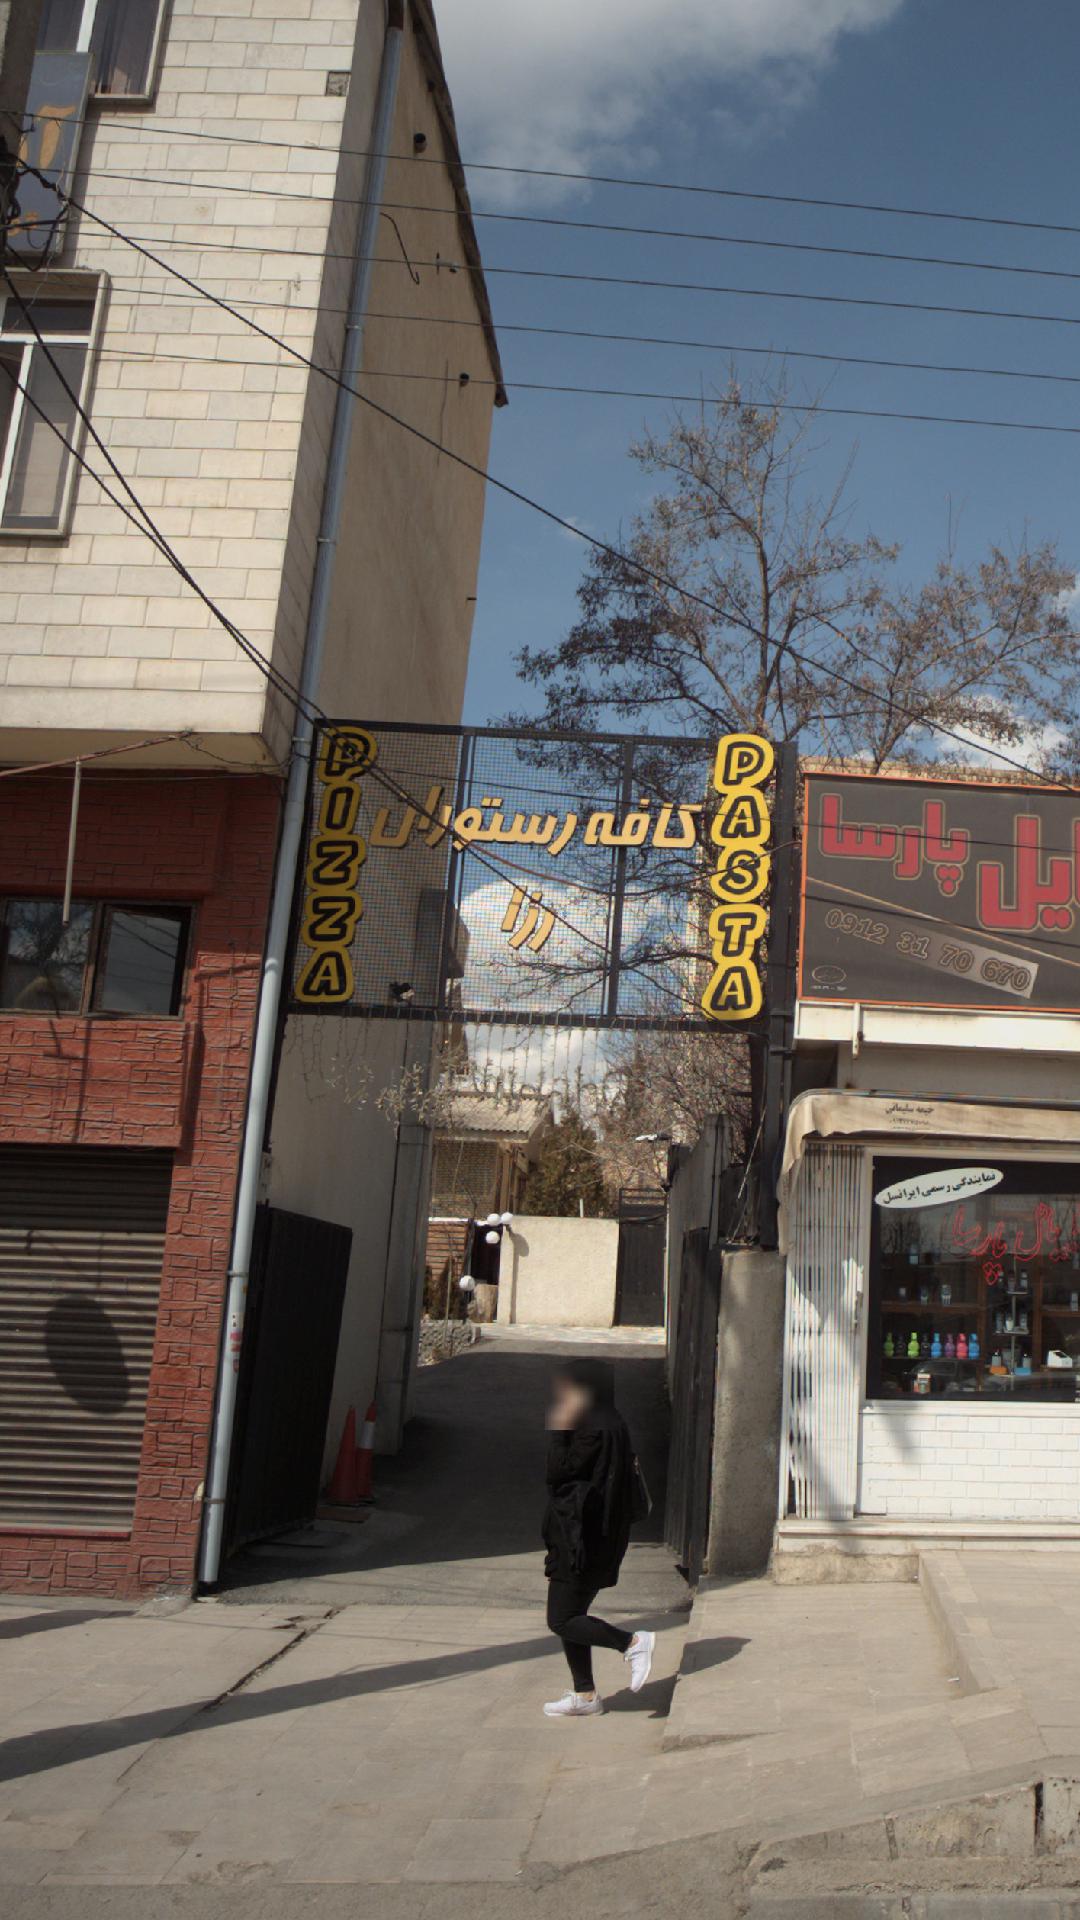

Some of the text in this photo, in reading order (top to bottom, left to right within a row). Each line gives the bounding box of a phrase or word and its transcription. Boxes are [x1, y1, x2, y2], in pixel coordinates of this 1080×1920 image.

[294, 725, 378, 1005] PIZZA
[369, 785, 702, 855] کافه رستوران
[819, 793, 970, 896] پارسا
[702, 733, 774, 1022] PASTA
[825, 909, 1031, 991] 0912 31 70 670
[883, 1170, 997, 1205] نمایندگی رسمی ایرانسل
